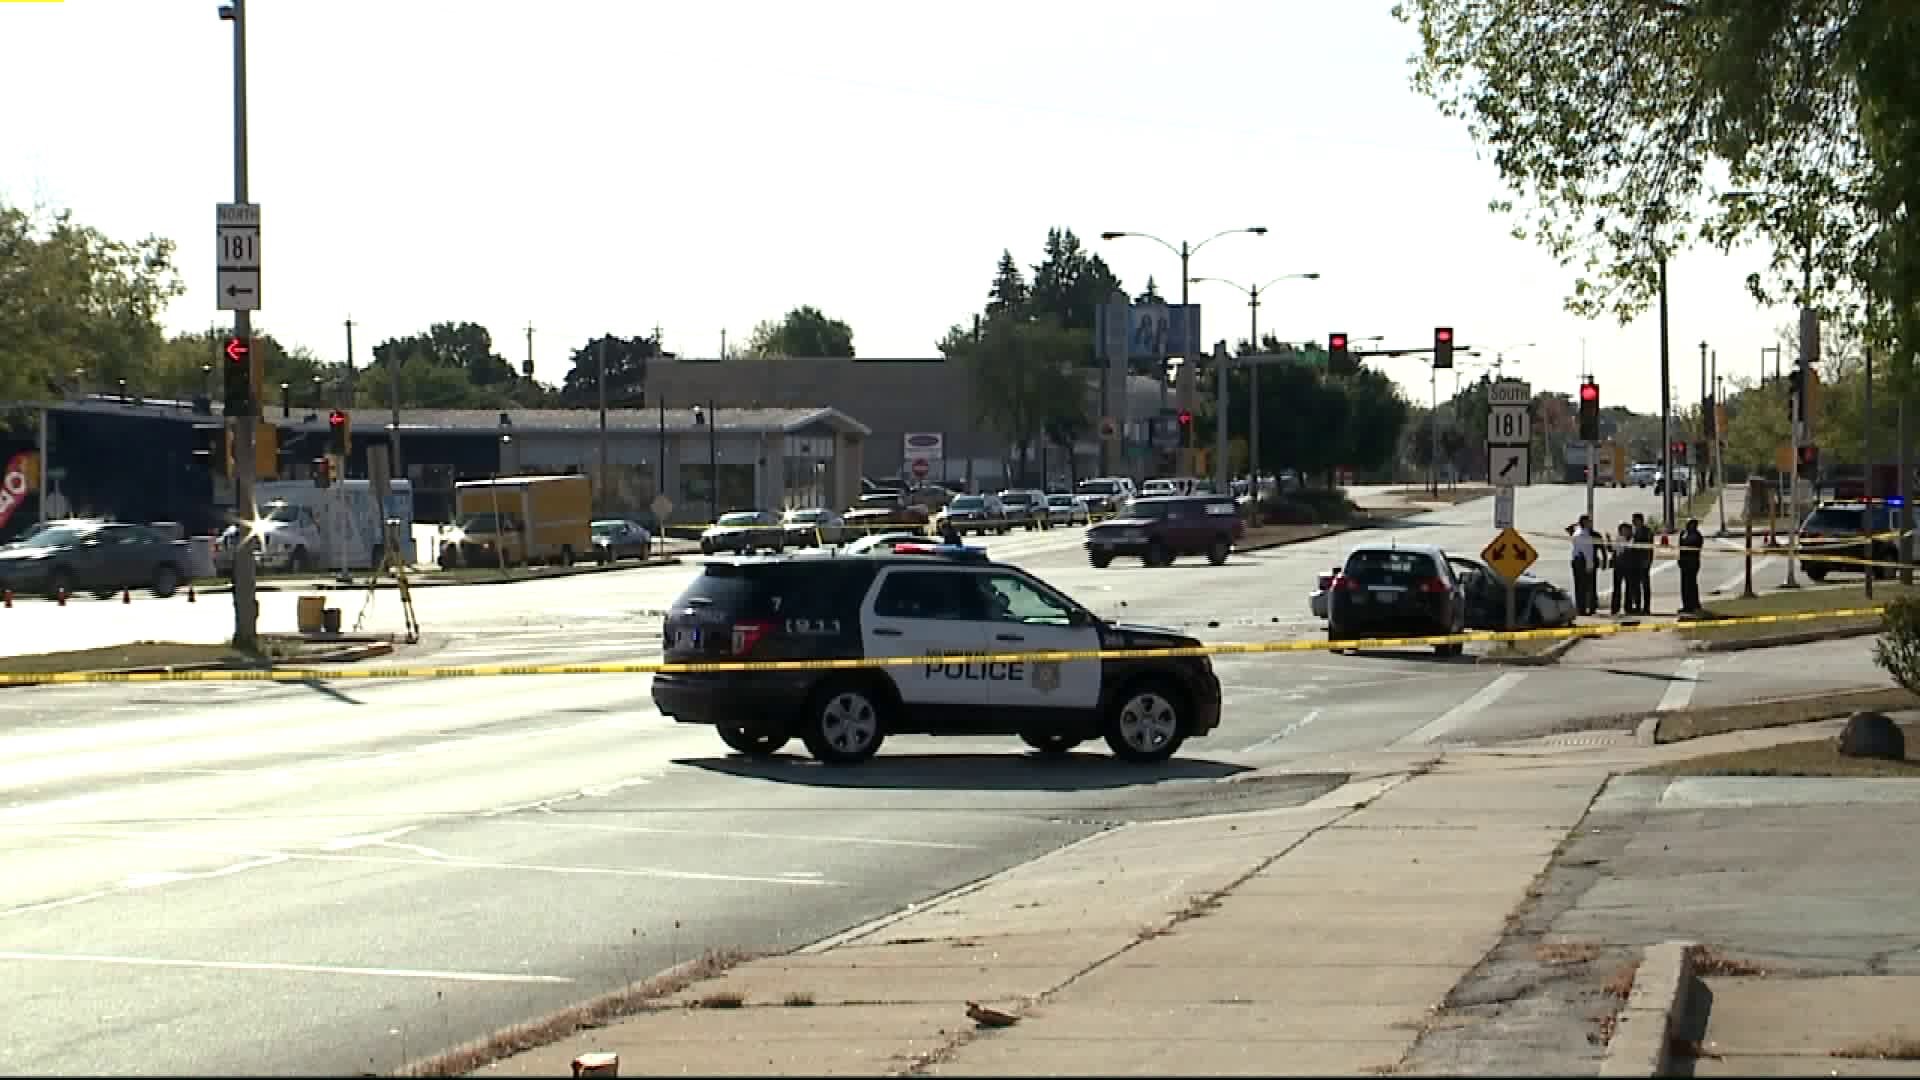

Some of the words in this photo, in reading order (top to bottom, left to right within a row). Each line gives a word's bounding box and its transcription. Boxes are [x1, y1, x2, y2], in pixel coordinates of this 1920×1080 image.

[224, 236, 252, 260] 181
[1496, 413, 1522, 436] 181
[925, 658, 1024, 681] POLICE
